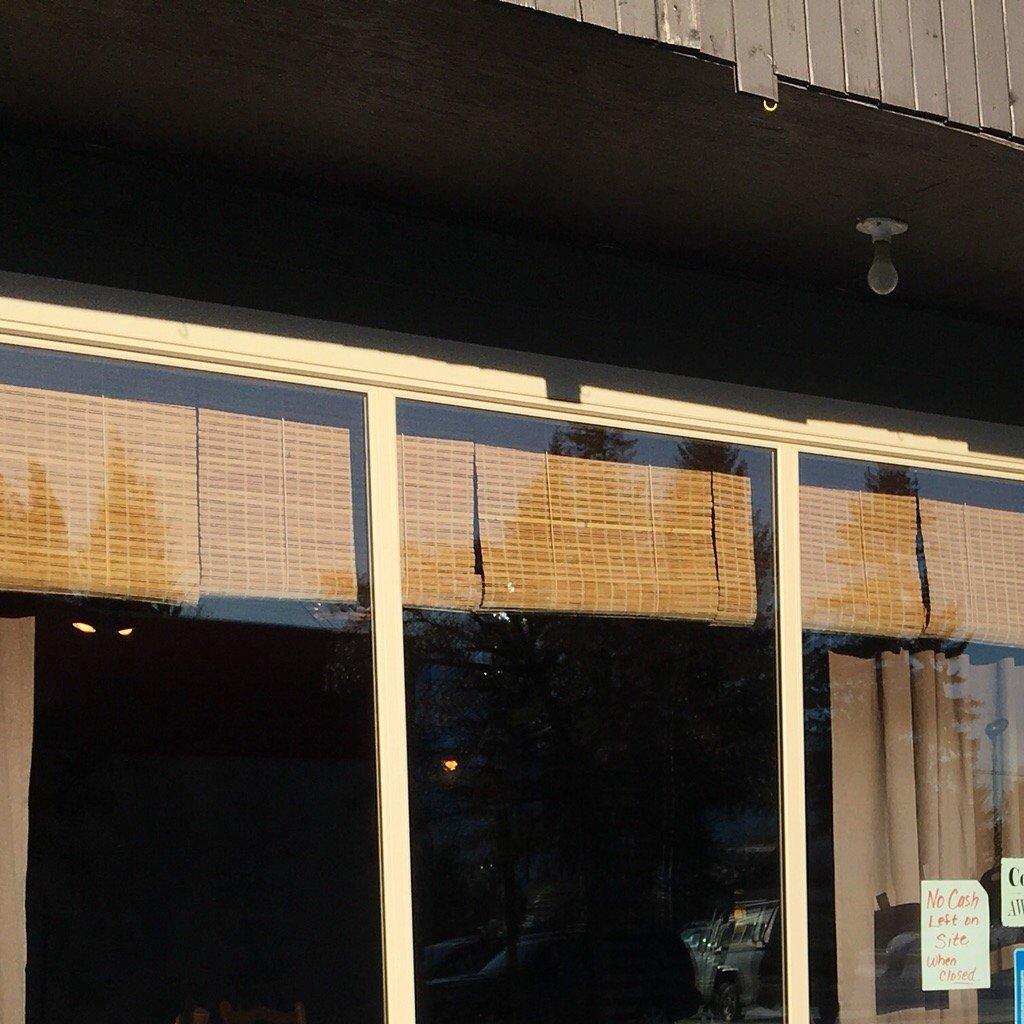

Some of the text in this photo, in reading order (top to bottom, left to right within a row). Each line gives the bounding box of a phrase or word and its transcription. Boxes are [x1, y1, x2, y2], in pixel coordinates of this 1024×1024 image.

[927, 888, 980, 910] No Cash
[964, 915, 979, 926] on
[934, 932, 969, 950] Site
